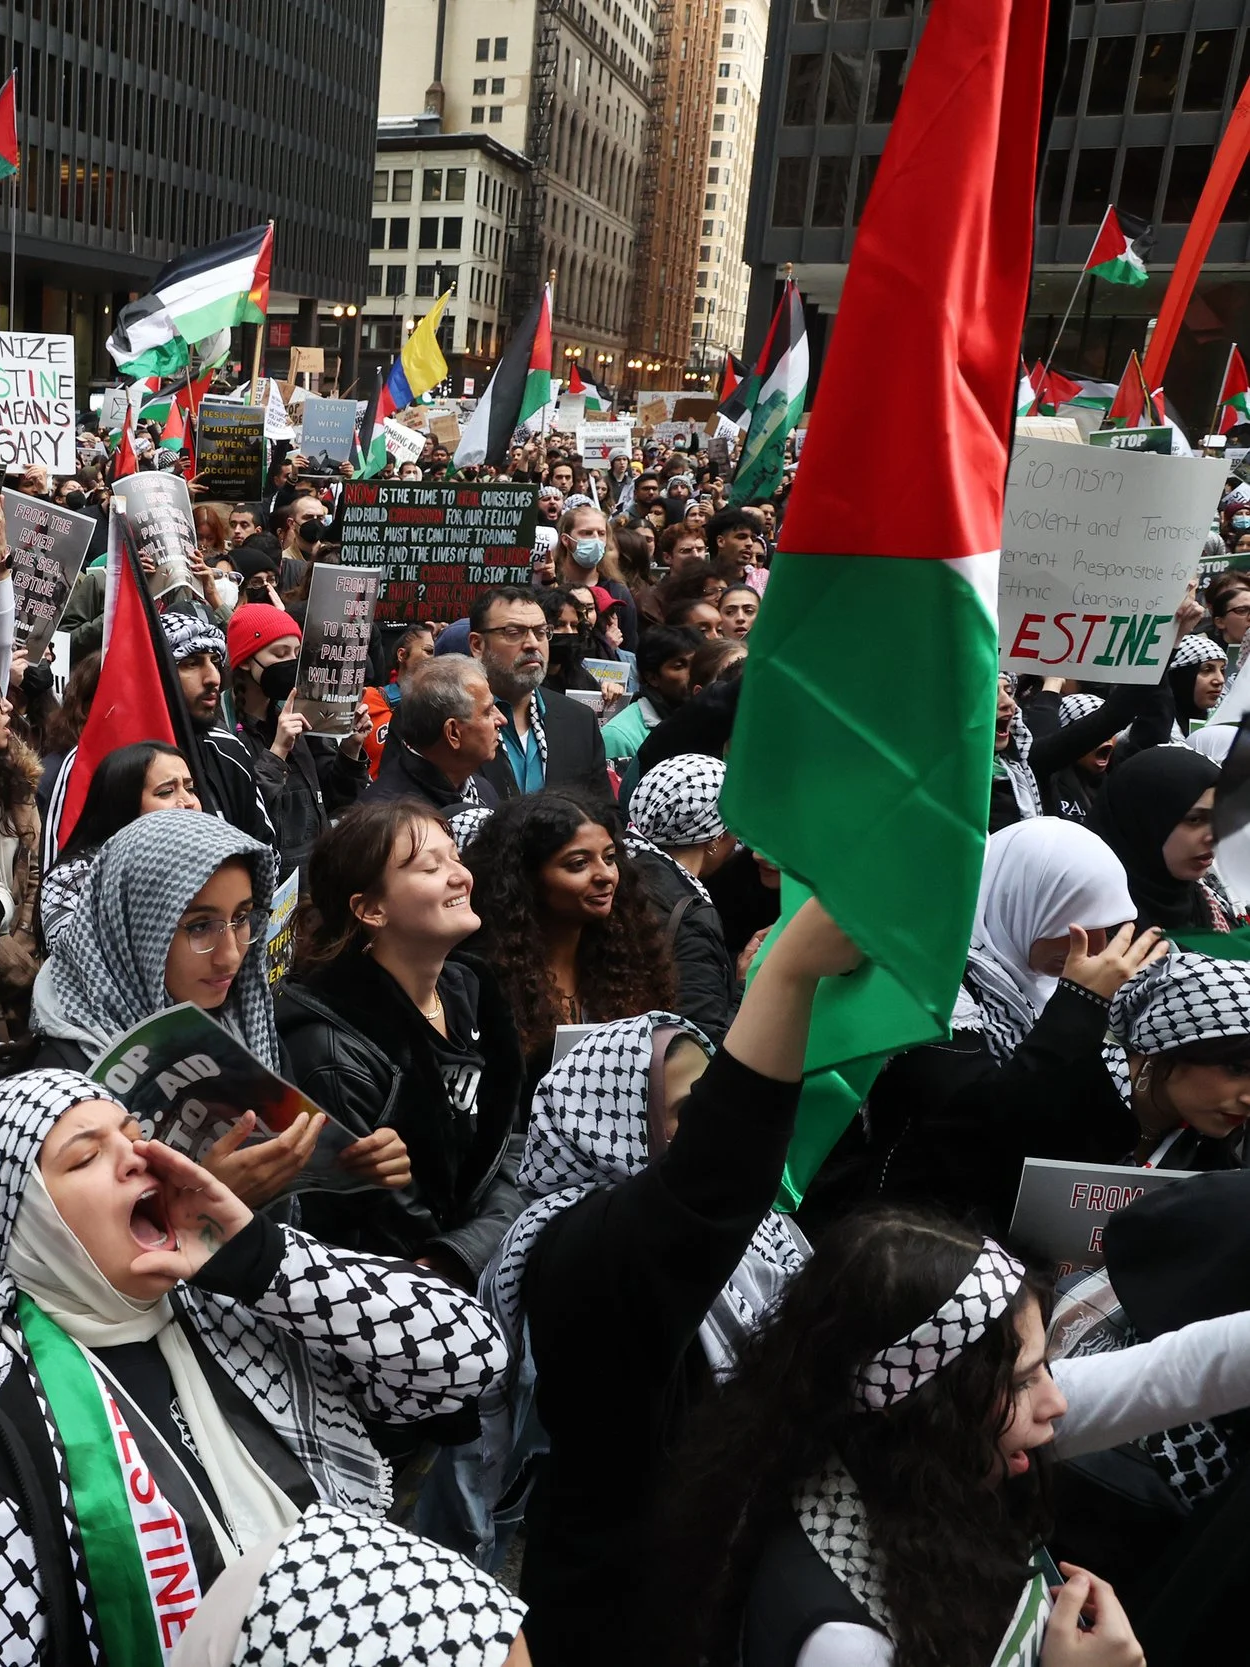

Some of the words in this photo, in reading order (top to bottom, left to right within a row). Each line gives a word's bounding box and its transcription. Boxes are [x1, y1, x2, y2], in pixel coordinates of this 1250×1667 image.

[213, 426, 259, 435] JUSTIFIED
[304, 435, 350, 444] PALESTINE
[215, 440, 243, 448] WHEN
[1110, 434, 1148, 448] STOP
[201, 453, 237, 461] PEOPLE
[204, 467, 255, 475] OCCUPIED
[344, 485, 378, 505] NOW
[379, 488, 388, 502] IS
[390, 488, 409, 504] THE
[413, 489, 437, 505] TIME
[441, 489, 455, 506] TO
[481, 490, 533, 507] OURSELVES
[15, 504, 49, 527] FROM
[51, 514, 73, 534] THE
[344, 507, 363, 522] AND
[363, 508, 387, 522] BUILD
[446, 509, 463, 524] FOR
[464, 510, 481, 525] OUR
[484, 510, 522, 526] FELLOW
[342, 526, 381, 542] HUMANS.
[384, 526, 406, 543] MUST
[410, 527, 424, 543] WE
[426, 528, 471, 544] CONTINUE
[475, 528, 516, 544] TRADING
[1088, 517, 1121, 538] and
[19, 528, 54, 551] RIVER
[14, 548, 35, 567] THE
[341, 546, 359, 562] OUR
[361, 547, 386, 562] LIVES
[387, 547, 408, 562] AND
[410, 547, 428, 562] THE
[432, 548, 456, 563] LIVES
[457, 548, 469, 563] OF
[469, 548, 485, 563] OUR
[400, 565, 418, 581] THE
[469, 566, 481, 582] TO
[483, 566, 507, 583] STOP
[509, 566, 531, 583] THE
[1073, 550, 1164, 581] Responsible
[1171, 562, 1190, 581] for
[1197, 561, 1230, 572] STOP
[336, 576, 364, 592] FROM
[26, 598, 56, 620] FREE
[344, 601, 369, 615] RIVER
[404, 603, 414, 619] A
[1145, 596, 1164, 610] of
[323, 621, 338, 637] TO
[341, 622, 358, 638] THE
[321, 644, 367, 661] PALESTINE
[308, 667, 338, 684] WILL
[341, 668, 354, 685] BE
[105, 1045, 149, 1094] OP
[155, 1053, 222, 1101] AID
[165, 1098, 208, 1150] TO
[1070, 1183, 1144, 1212] FROM
